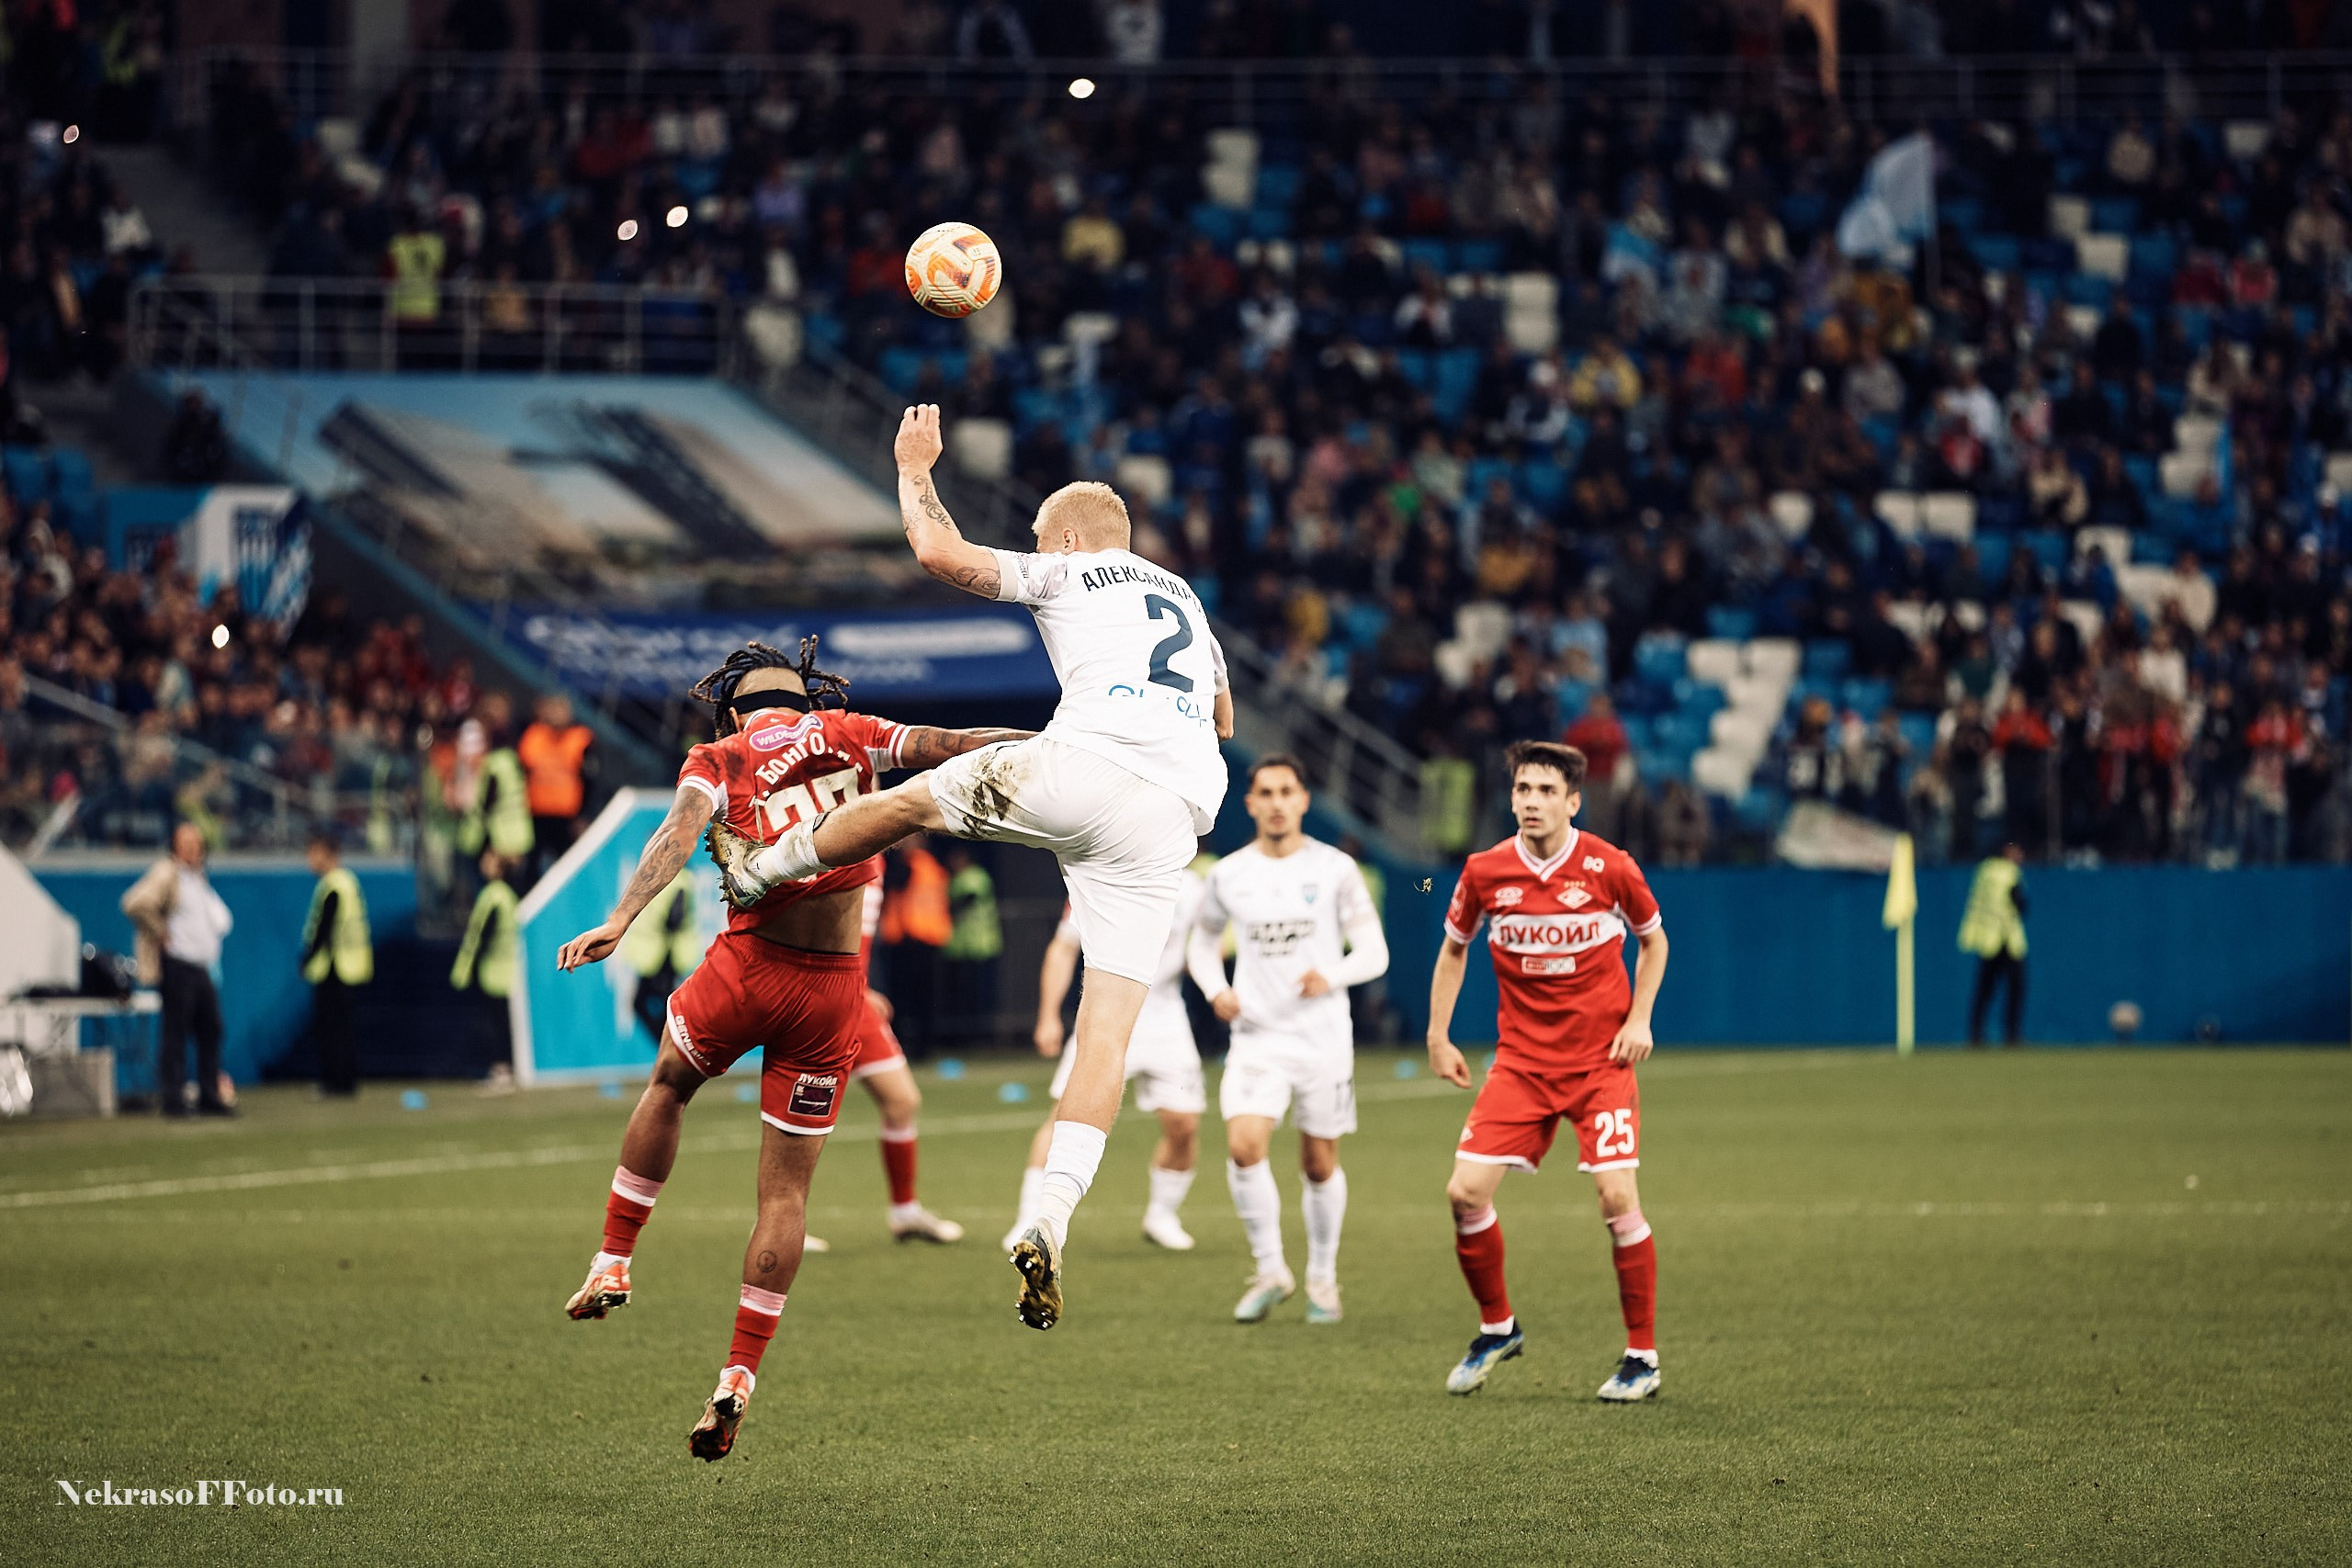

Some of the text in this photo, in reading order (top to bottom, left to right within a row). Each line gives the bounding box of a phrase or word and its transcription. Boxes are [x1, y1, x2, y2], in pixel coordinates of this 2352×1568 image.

[1081, 565, 1205, 619] АЛЕКСАНДР
[1144, 593, 1193, 693] 2
[1499, 920, 1600, 946] ЛУКОЙЛ
[797, 1073, 838, 1087] ЛУКОЙЛ
[1594, 1109, 1634, 1157] 25
